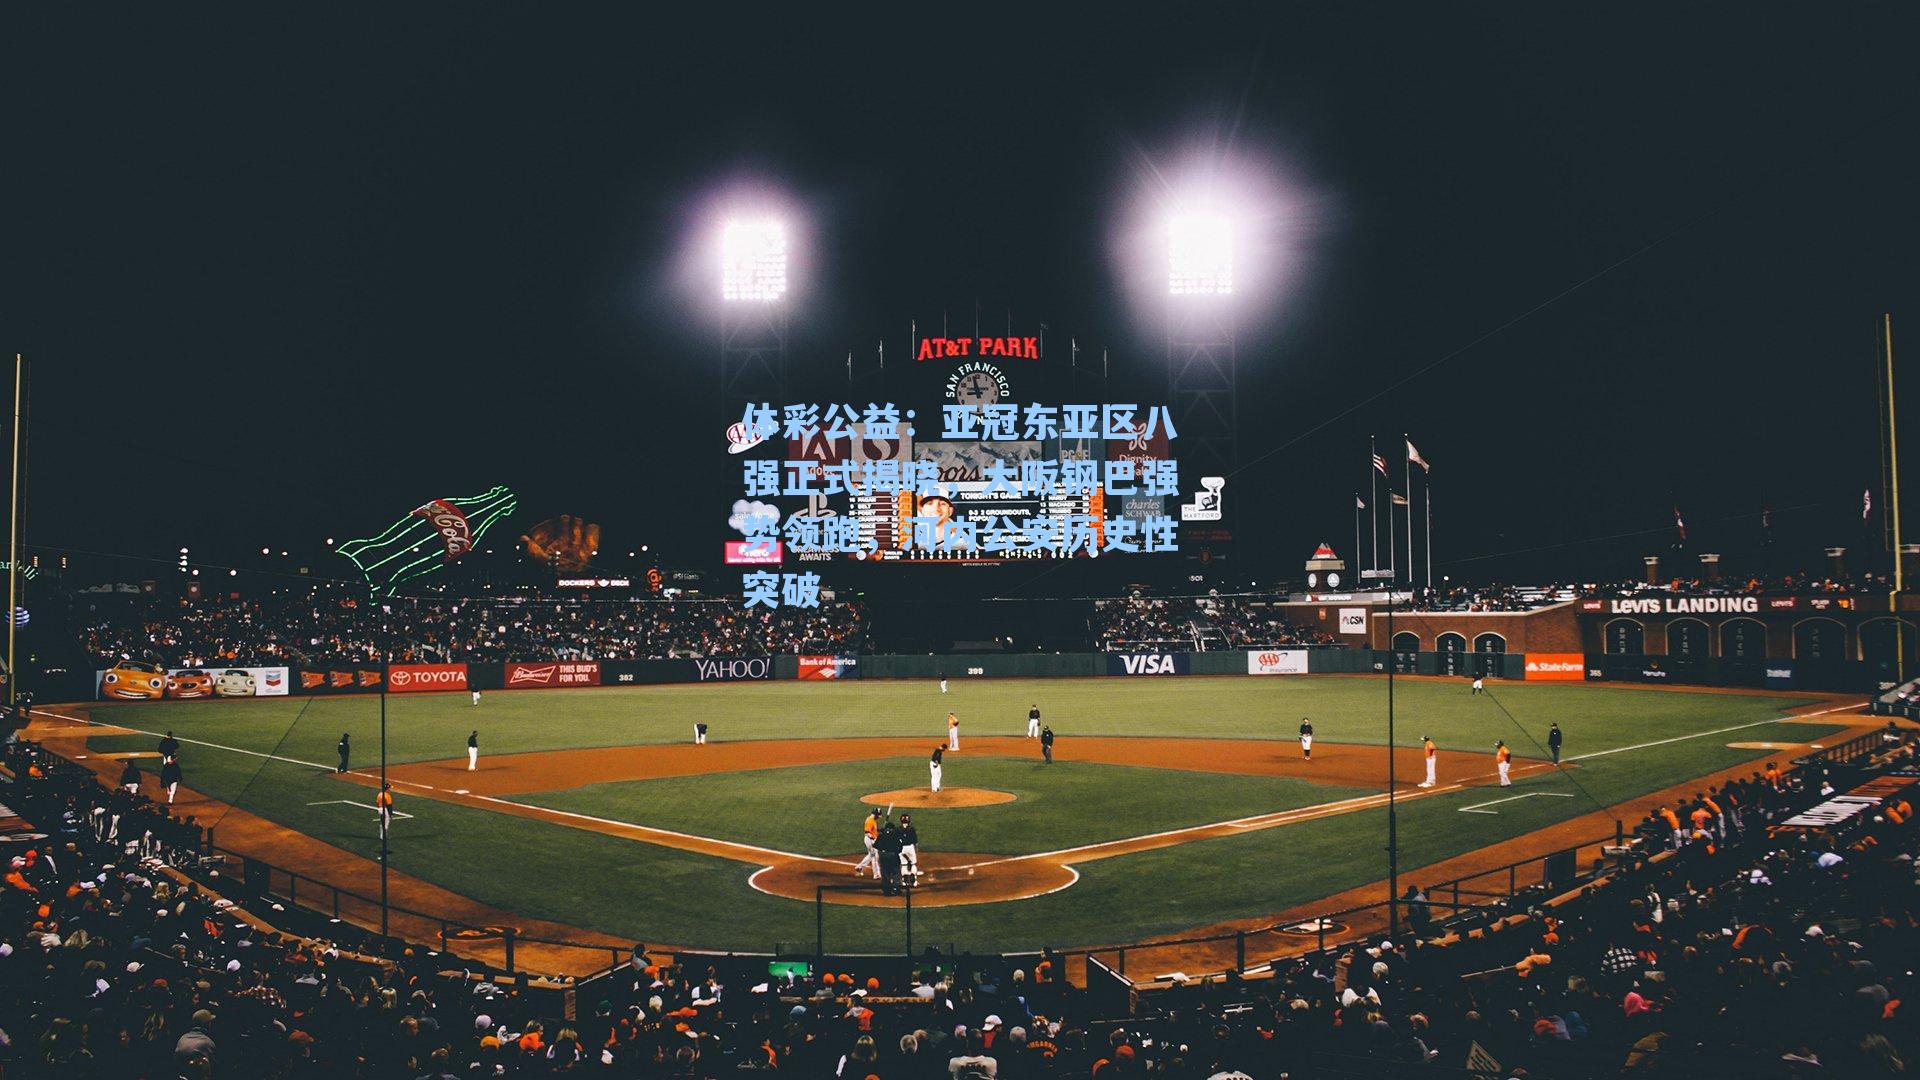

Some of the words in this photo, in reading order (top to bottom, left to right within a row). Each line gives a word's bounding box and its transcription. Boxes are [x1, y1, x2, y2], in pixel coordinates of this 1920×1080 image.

[917, 337, 973, 360] AT&T
[978, 336, 1039, 360] PARK
[945, 373, 960, 398] SAN
[958, 361, 1010, 397] FRANCISCO
[1125, 499, 1161, 510] charles
[798, 553, 832, 561] AWAITS
[610, 579, 630, 587] DECK
[1665, 598, 1758, 613] LANDING
[1349, 616, 1364, 625] CSN
[800, 658, 819, 666] Bank
[819, 658, 826, 666] of
[826, 658, 857, 666] America
[1119, 654, 1176, 675] VISA
[559, 665, 576, 674] THIS
[577, 664, 598, 673] BUD'S
[695, 658, 771, 681] YAHOO!
[413, 670, 467, 684] TOYOTA
[559, 674, 573, 683] FOR
[574, 674, 591, 683] YOU.
